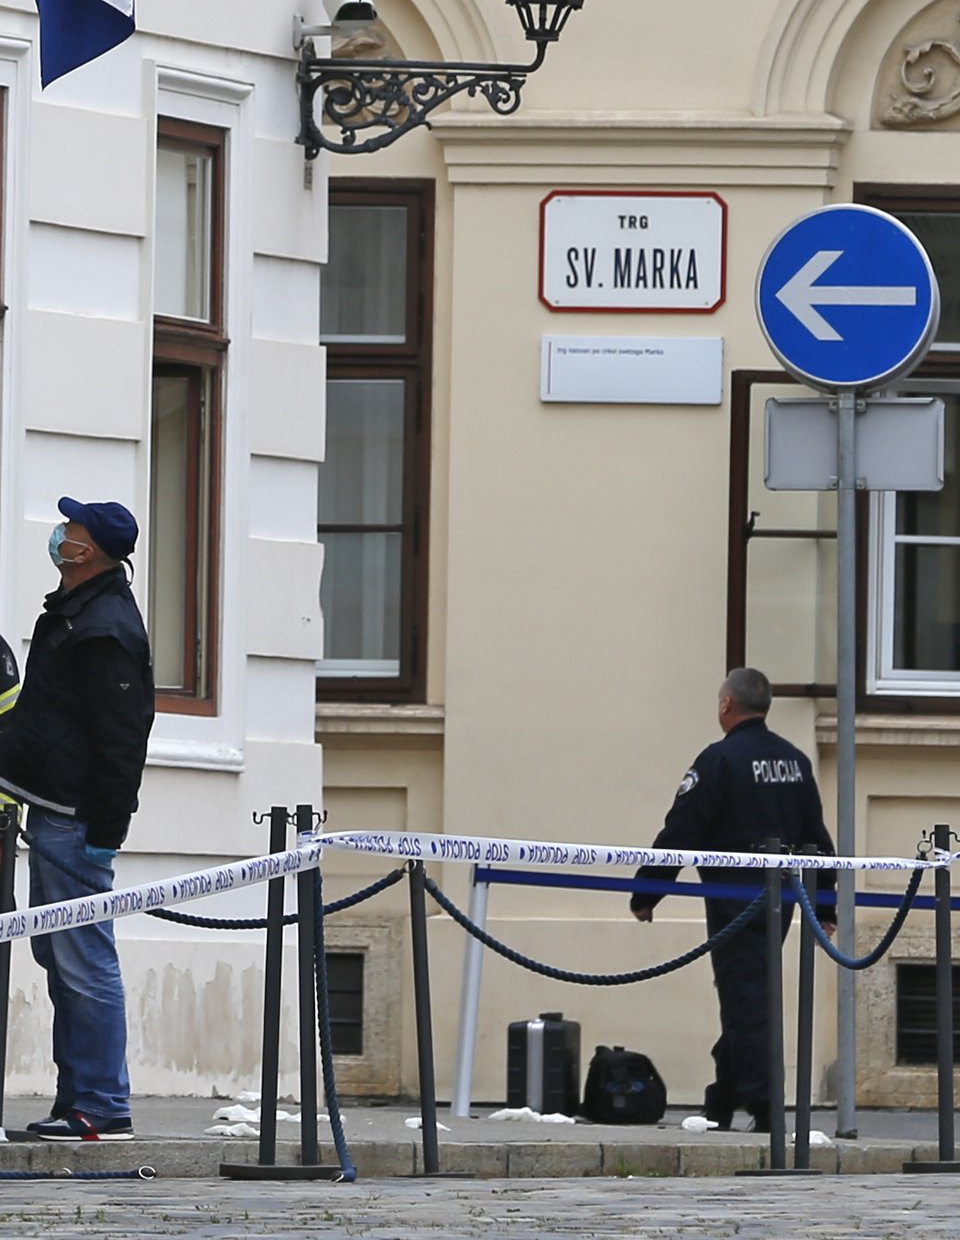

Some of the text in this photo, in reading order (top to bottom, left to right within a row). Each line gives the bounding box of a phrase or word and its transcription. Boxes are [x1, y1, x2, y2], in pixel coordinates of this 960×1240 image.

[617, 215, 649, 230] TRG
[566, 247, 699, 291] SV. MARKA
[752, 760, 804, 783] POLICIJA
[398, 836, 422, 856] STOP
[440, 839, 481, 859] POLICIJA
[485, 842, 510, 861] STOP
[528, 845, 569, 864] POLICIJA
[572, 848, 597, 865] STOP
[246, 858, 280, 882] POLICIJA
[282, 850, 303, 872] STOP
[179, 874, 213, 899] POLICIJA
[215, 869, 235, 889] STOP
[109, 891, 143, 916] POLICIJA
[146, 887, 166, 908] STOP
[40, 908, 73, 930] POLICIJA
[76, 901, 96, 923] STOP
[7, 915, 27, 937] STOP
